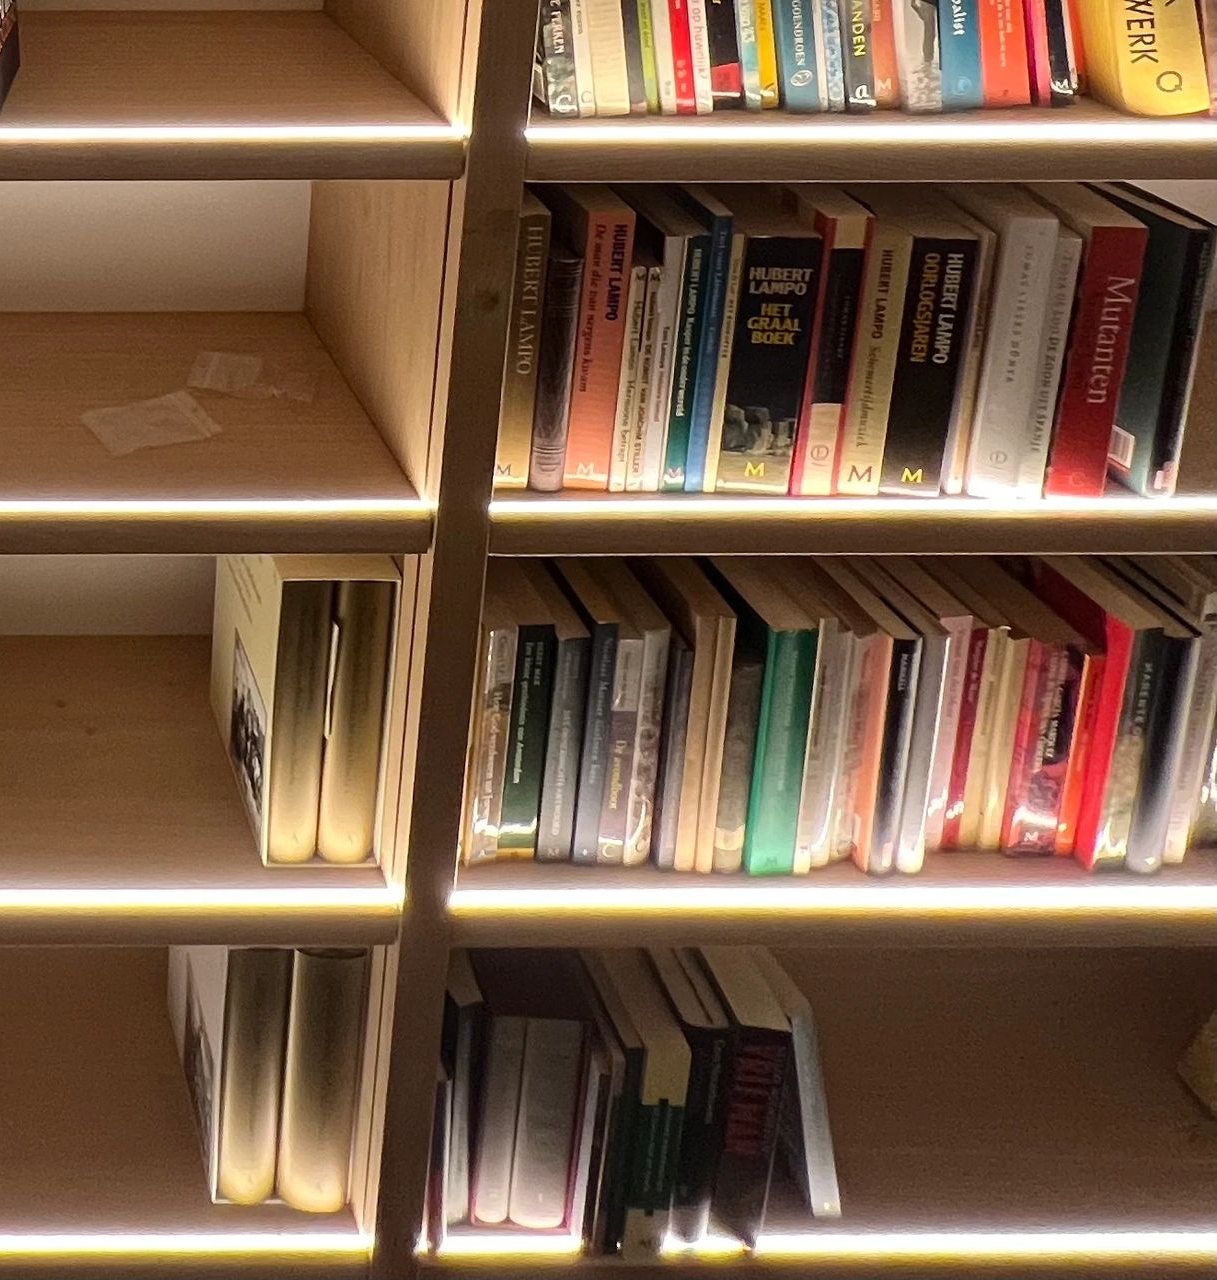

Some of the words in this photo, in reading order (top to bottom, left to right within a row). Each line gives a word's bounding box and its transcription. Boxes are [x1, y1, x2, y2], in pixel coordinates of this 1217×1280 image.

[791, 0, 805, 66] GOENDROEN
[522, 224, 545, 302] HUBERT
[609, 223, 629, 274] HUBERT
[748, 266, 815, 282] HUBERT
[604, 276, 623, 322] LAMPO
[748, 281, 809, 296] LAMPO
[940, 252, 965, 312] HUBERT
[746, 317, 802, 332] GRAAL
[761, 302, 794, 317] HET
[909, 252, 940, 364] OORLOGSJAREN
[515, 308, 538, 376] LAMPO
[750, 331, 796, 346] BOEK
[932, 313, 956, 364] LAMPO
[1085, 275, 1136, 405] Mutanten
